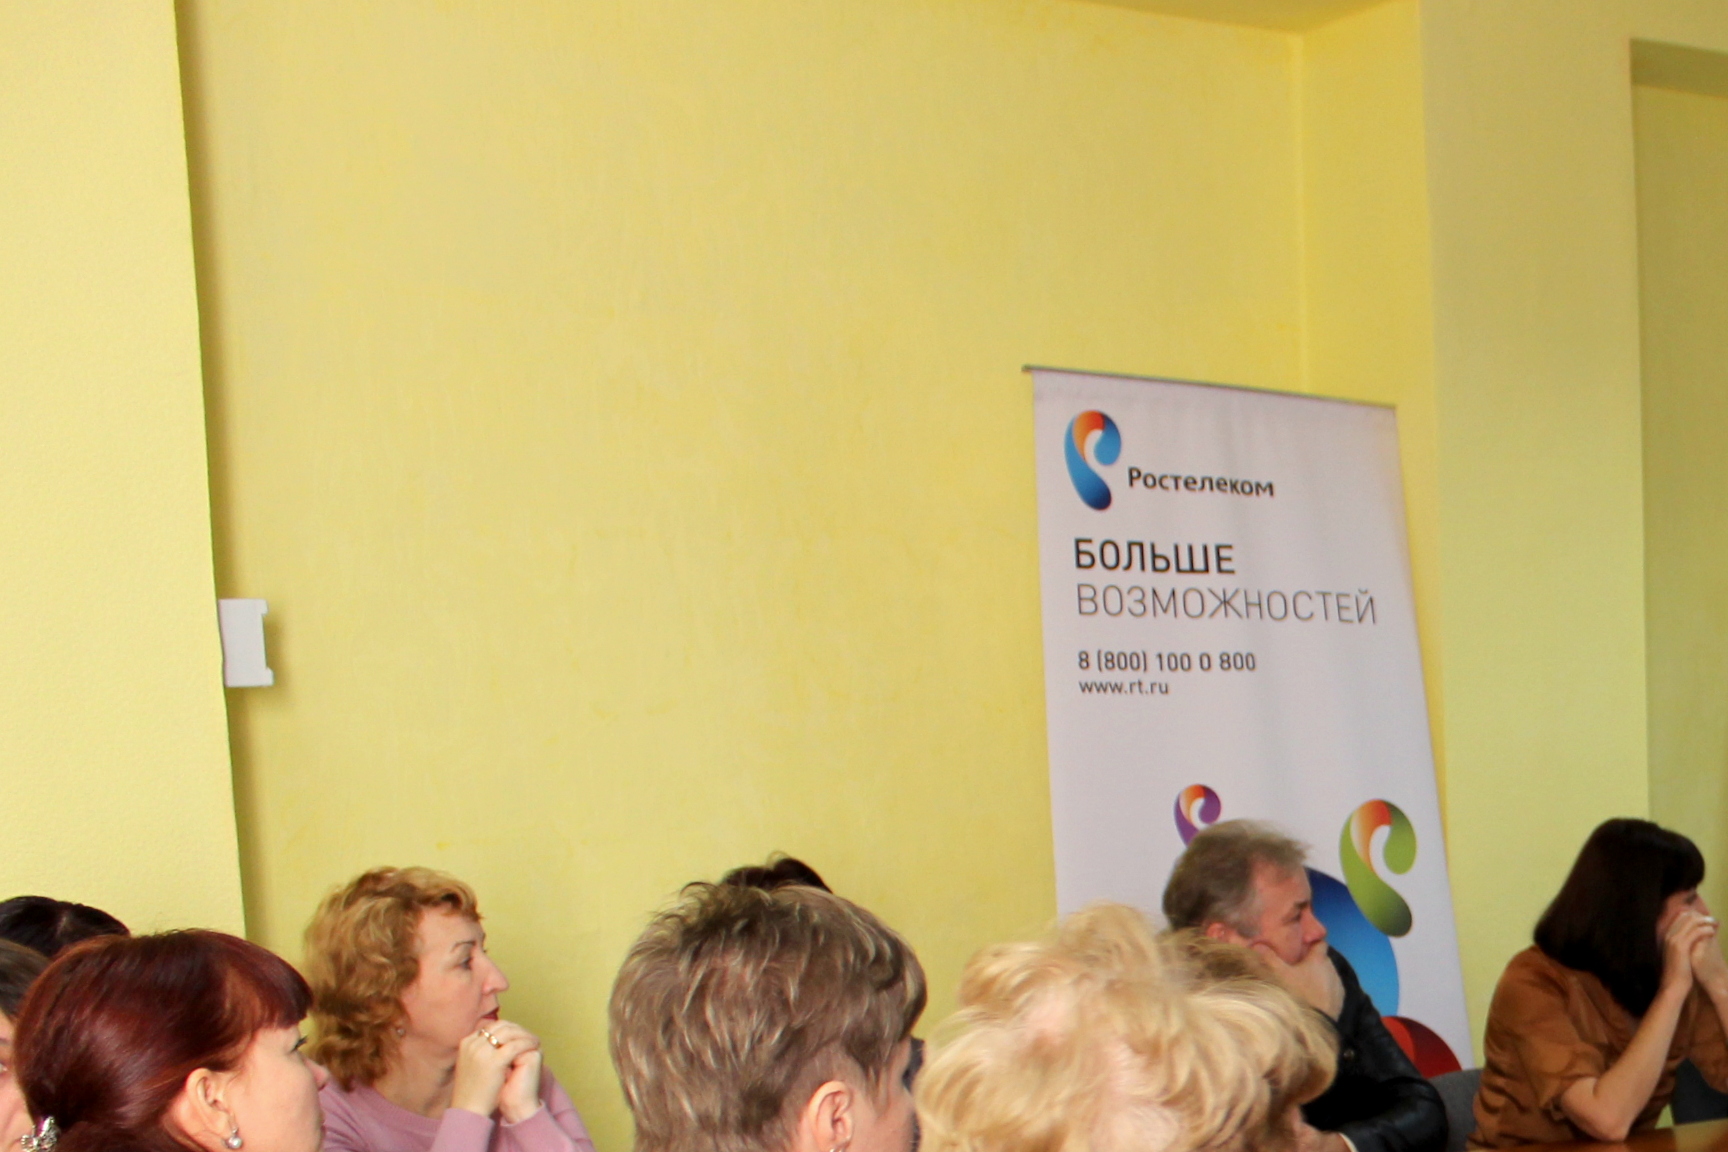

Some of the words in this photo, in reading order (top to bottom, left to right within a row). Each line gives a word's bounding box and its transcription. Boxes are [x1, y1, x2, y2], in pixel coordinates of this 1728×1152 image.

[1128, 466, 1274, 497] Ростелеком
[1074, 537, 1235, 574] БОЛЬШЕ
[1076, 583, 1376, 624] ВОЗМОЖНОСТЕЙ
[1077, 650, 1091, 671] 8
[1097, 649, 1148, 673] (800)
[1156, 652, 1192, 672] 100
[1199, 653, 1212, 672] 0
[1219, 652, 1257, 672] 800
[1078, 679, 1169, 695] www.rt.ru
